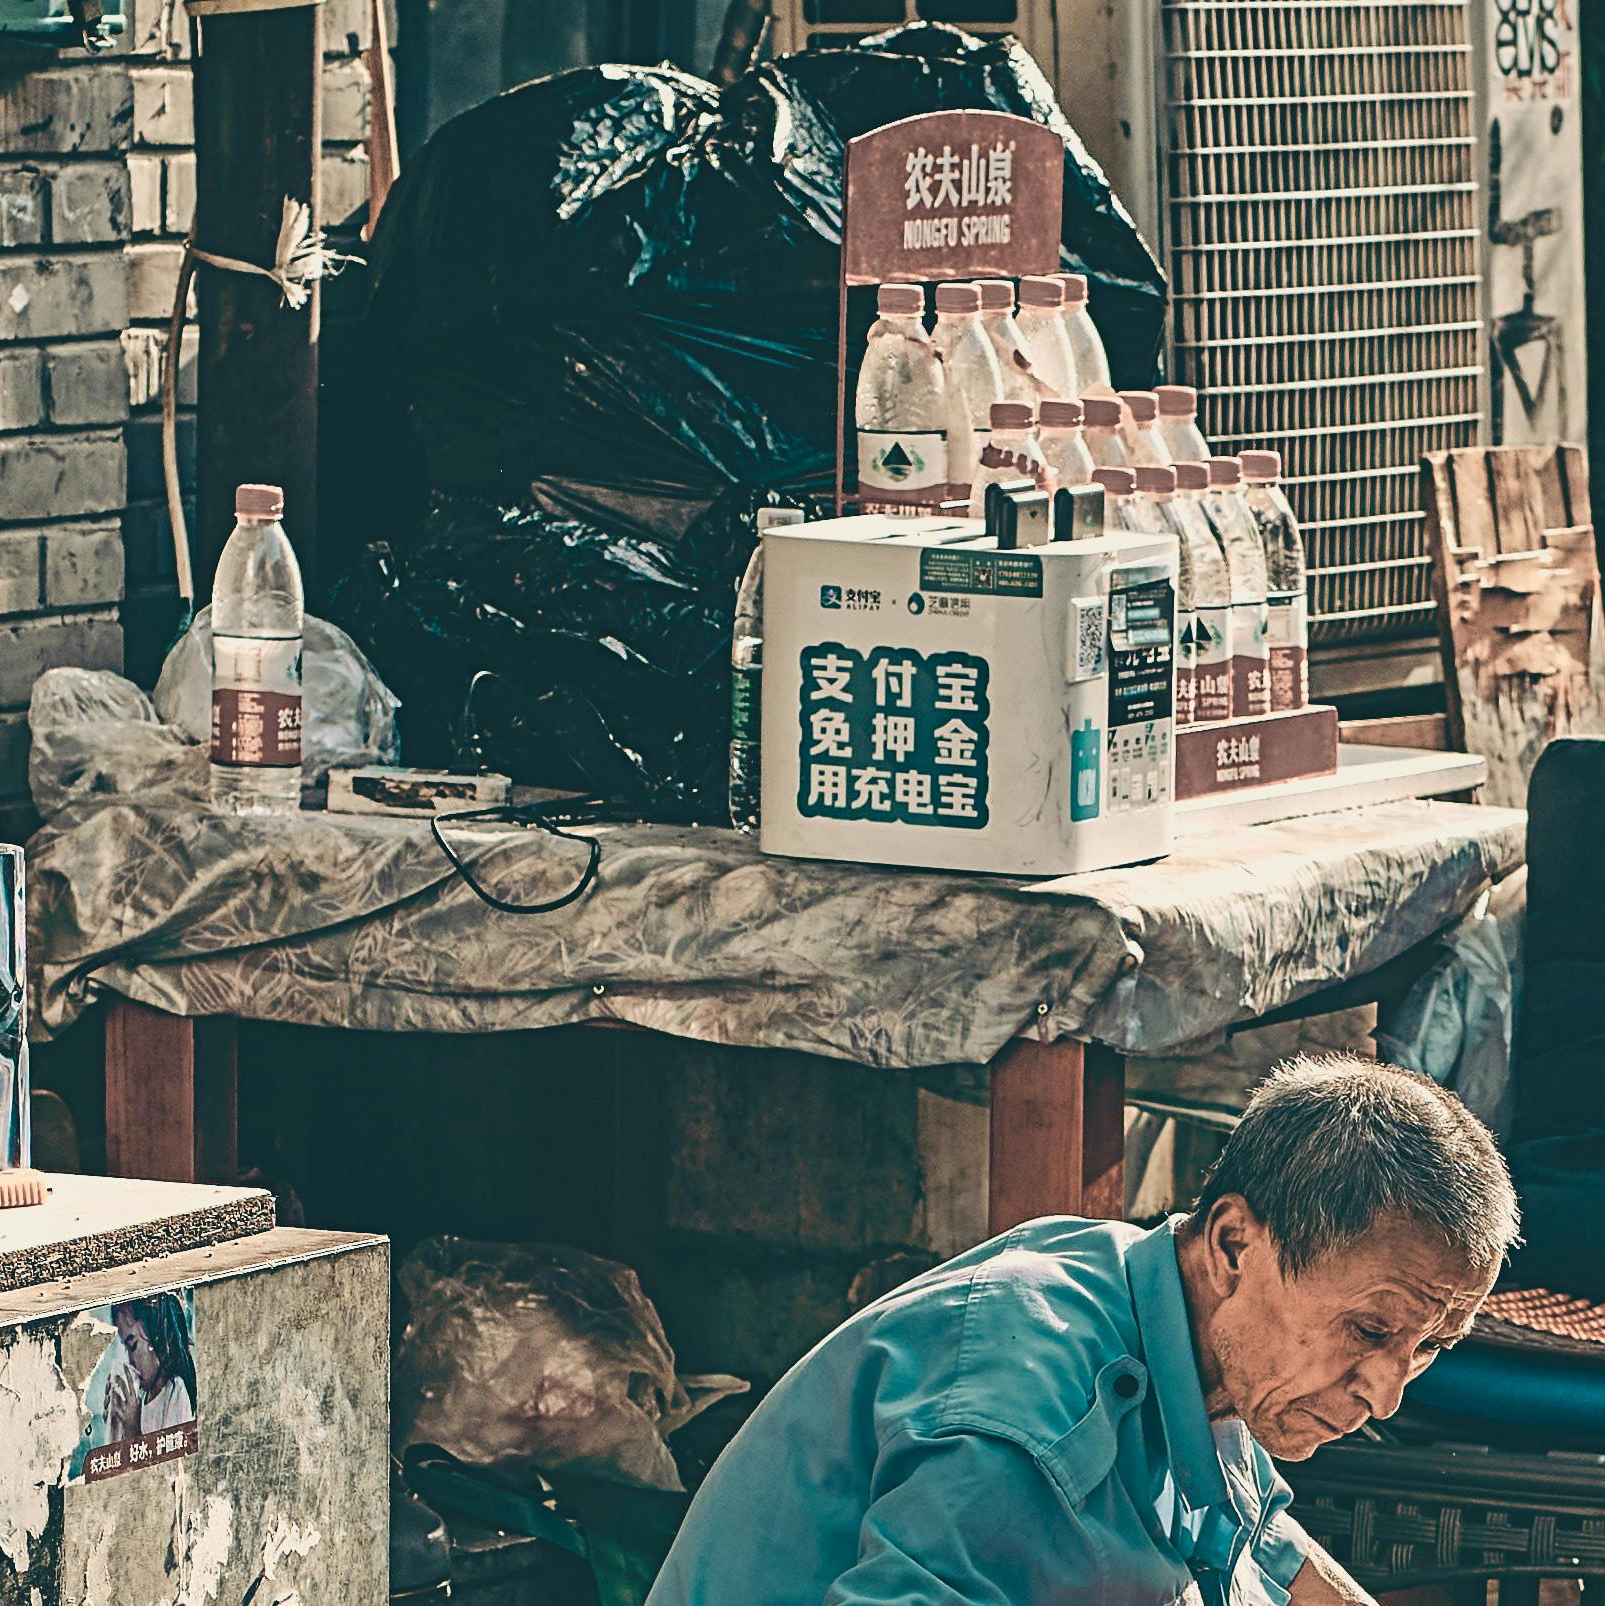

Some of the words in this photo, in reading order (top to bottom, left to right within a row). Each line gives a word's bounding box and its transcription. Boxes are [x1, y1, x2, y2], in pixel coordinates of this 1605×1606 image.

[904, 144, 1013, 209] 农夫山泉
[904, 217, 957, 250] NONGFU
[961, 214, 1011, 246] SPRING
[845, 588, 881, 604] 支付宝
[810, 654, 979, 711] 支付宝
[810, 708, 978, 767] 免押金
[807, 763, 978, 818] 用充电宝
[90, 1450, 122, 1474] 农夫山泉
